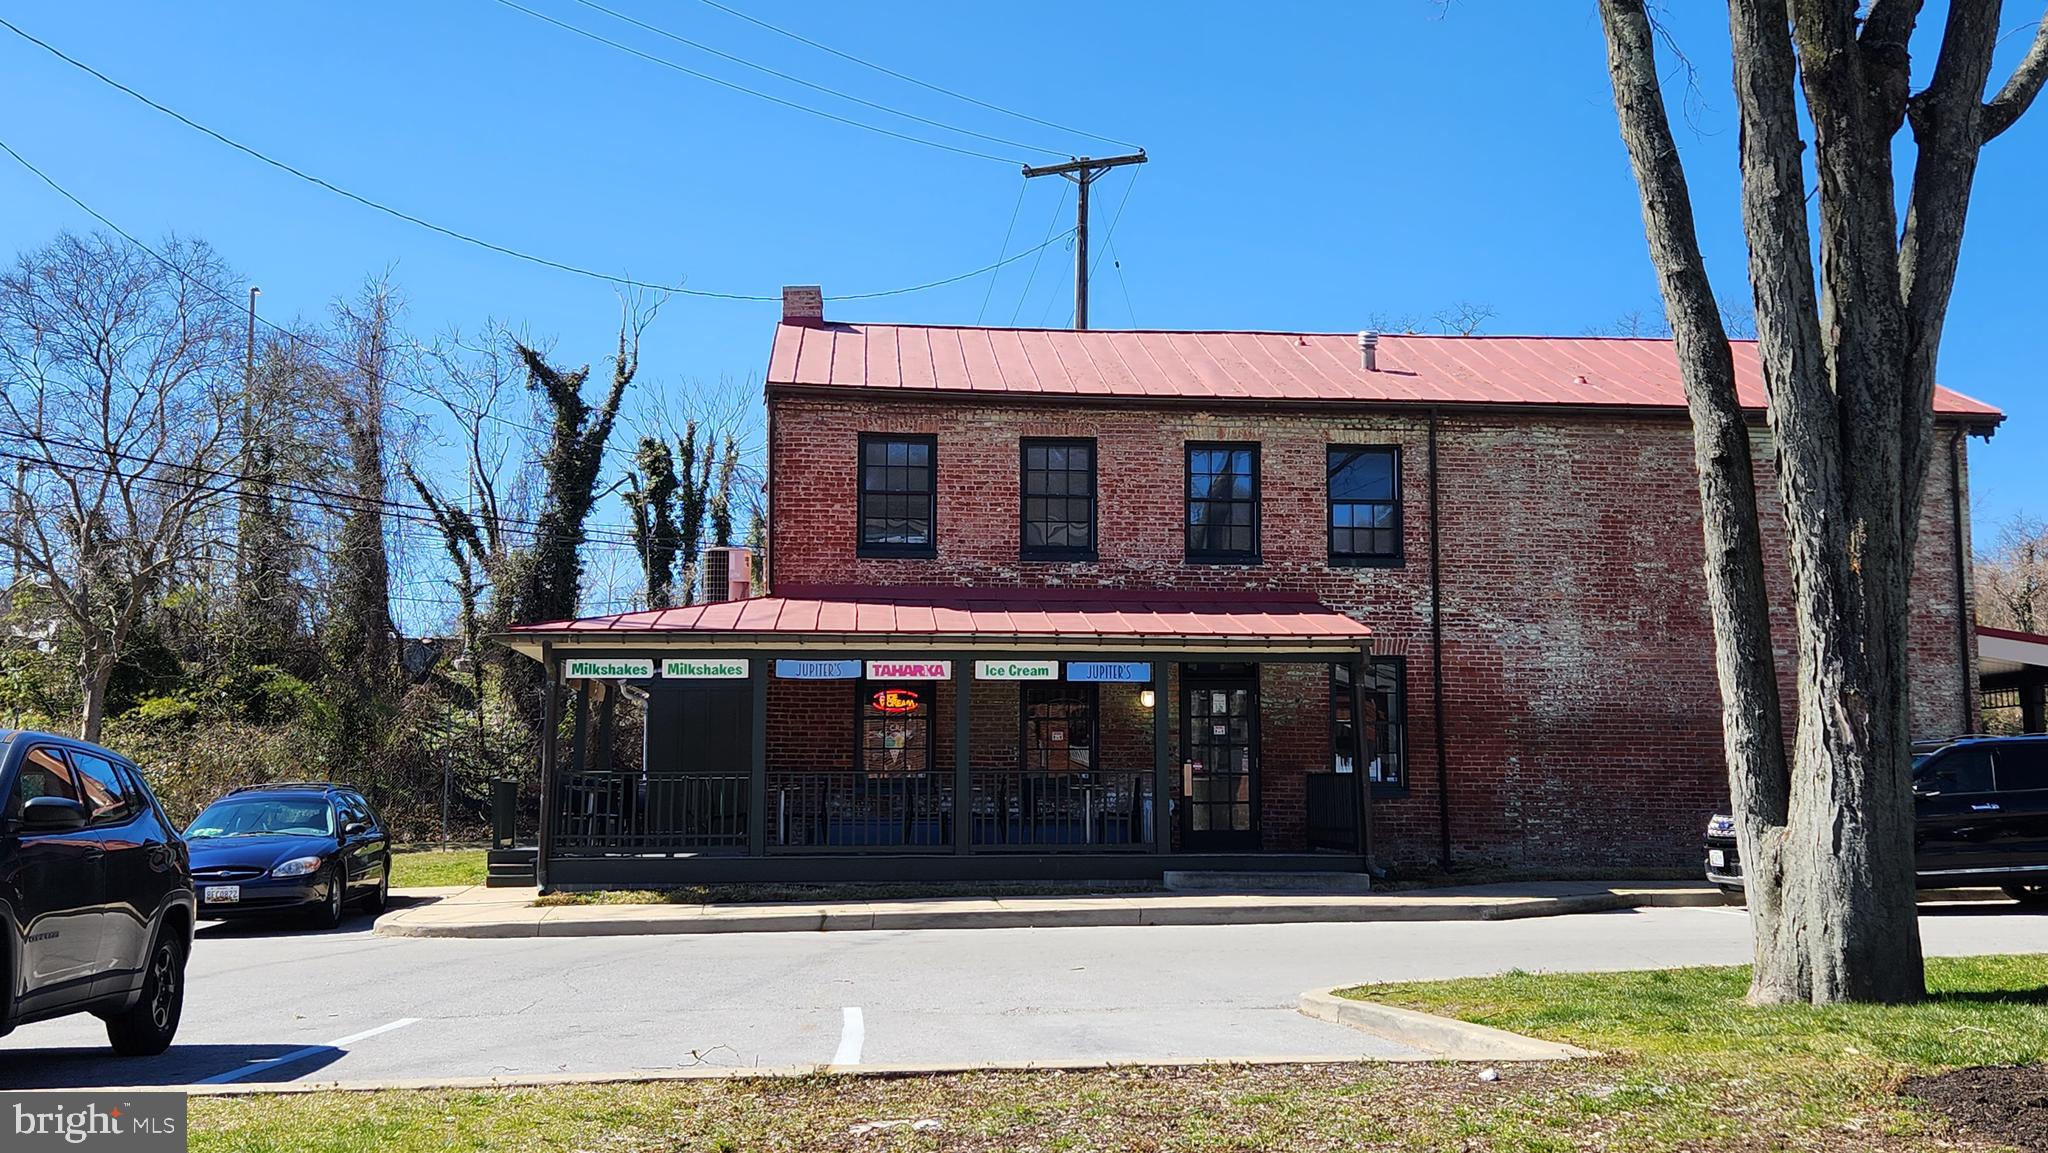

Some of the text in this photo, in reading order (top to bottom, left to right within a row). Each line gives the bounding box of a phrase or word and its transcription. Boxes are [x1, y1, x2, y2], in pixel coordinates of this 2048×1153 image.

[571, 663, 648, 675] Milkshakes
[667, 663, 743, 675] Milkshakes
[796, 663, 842, 677] JUPITER'S
[872, 664, 945, 677] TAHARKA
[985, 664, 1049, 676] Ice Cream
[1086, 665, 1131, 679] JUPITER'S
